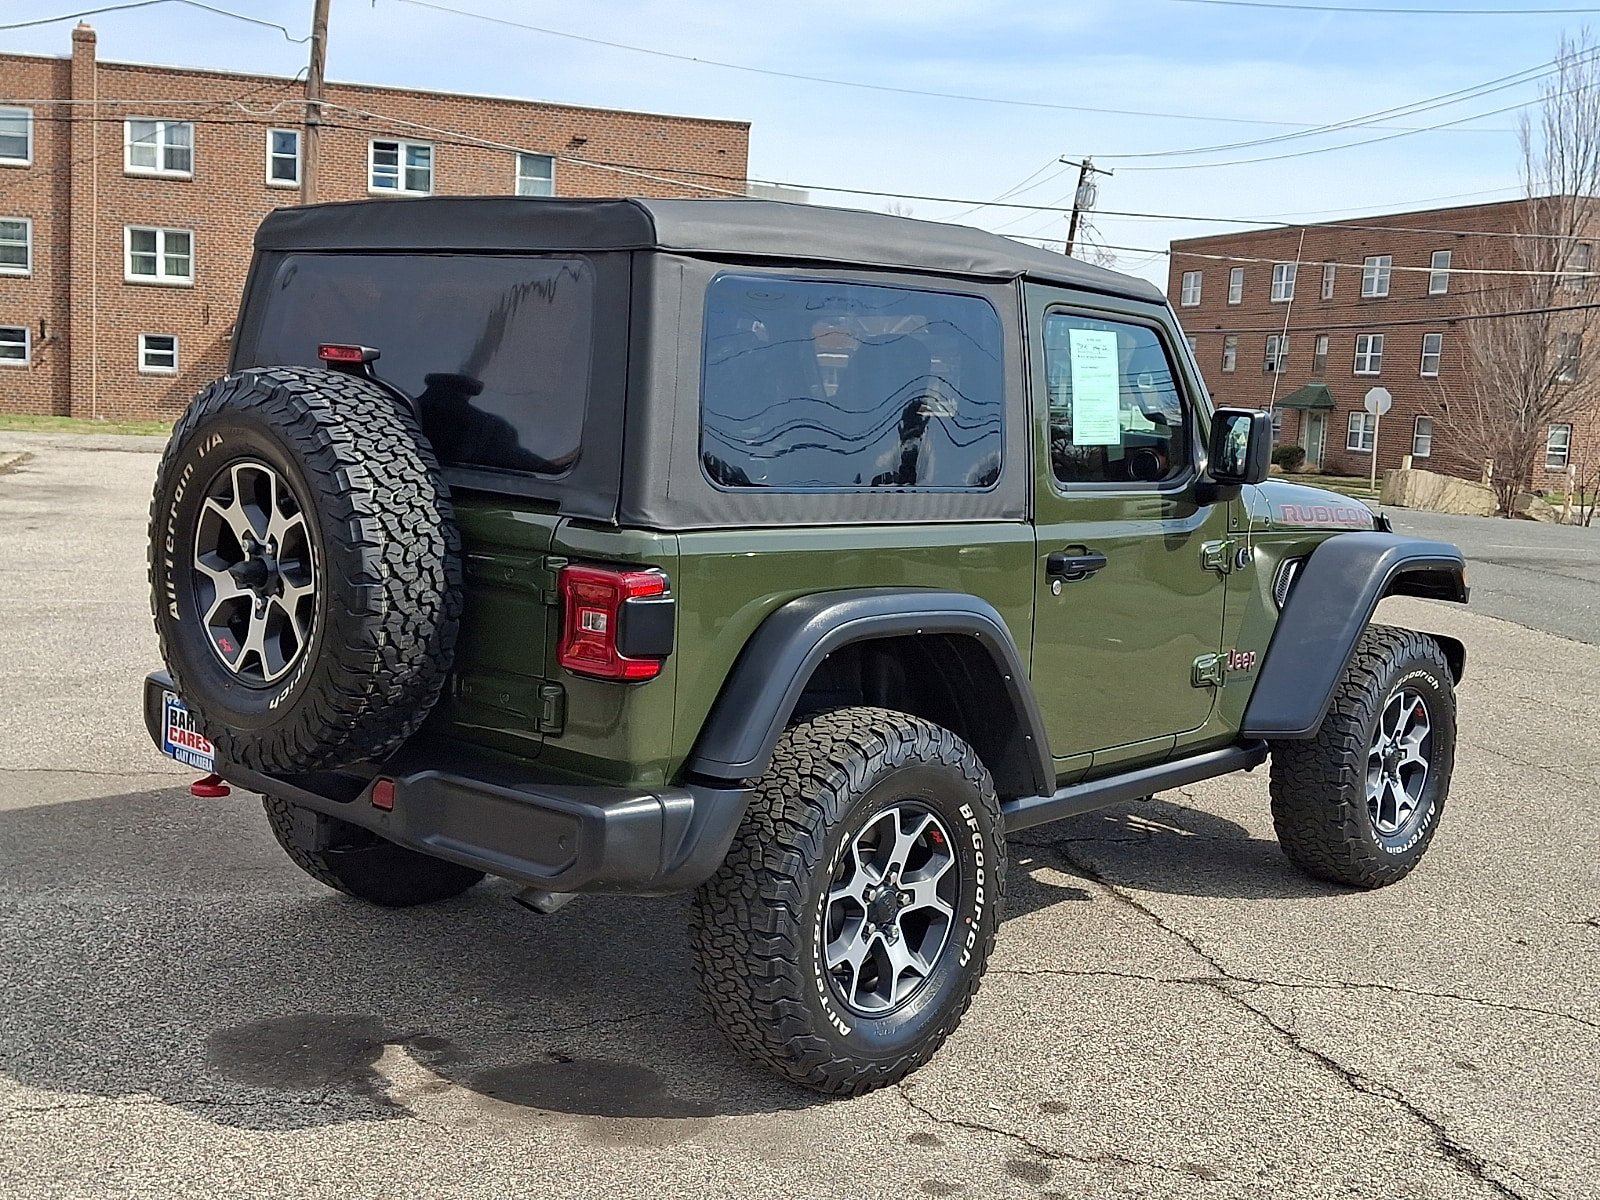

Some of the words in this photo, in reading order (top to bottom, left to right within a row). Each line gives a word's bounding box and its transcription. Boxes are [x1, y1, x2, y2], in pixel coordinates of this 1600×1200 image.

[1280, 505, 1371, 525] RUBICON
[1227, 649, 1257, 672] Jeep
[170, 726, 211, 753] CARES
[958, 803, 987, 969] BFGoodrich
